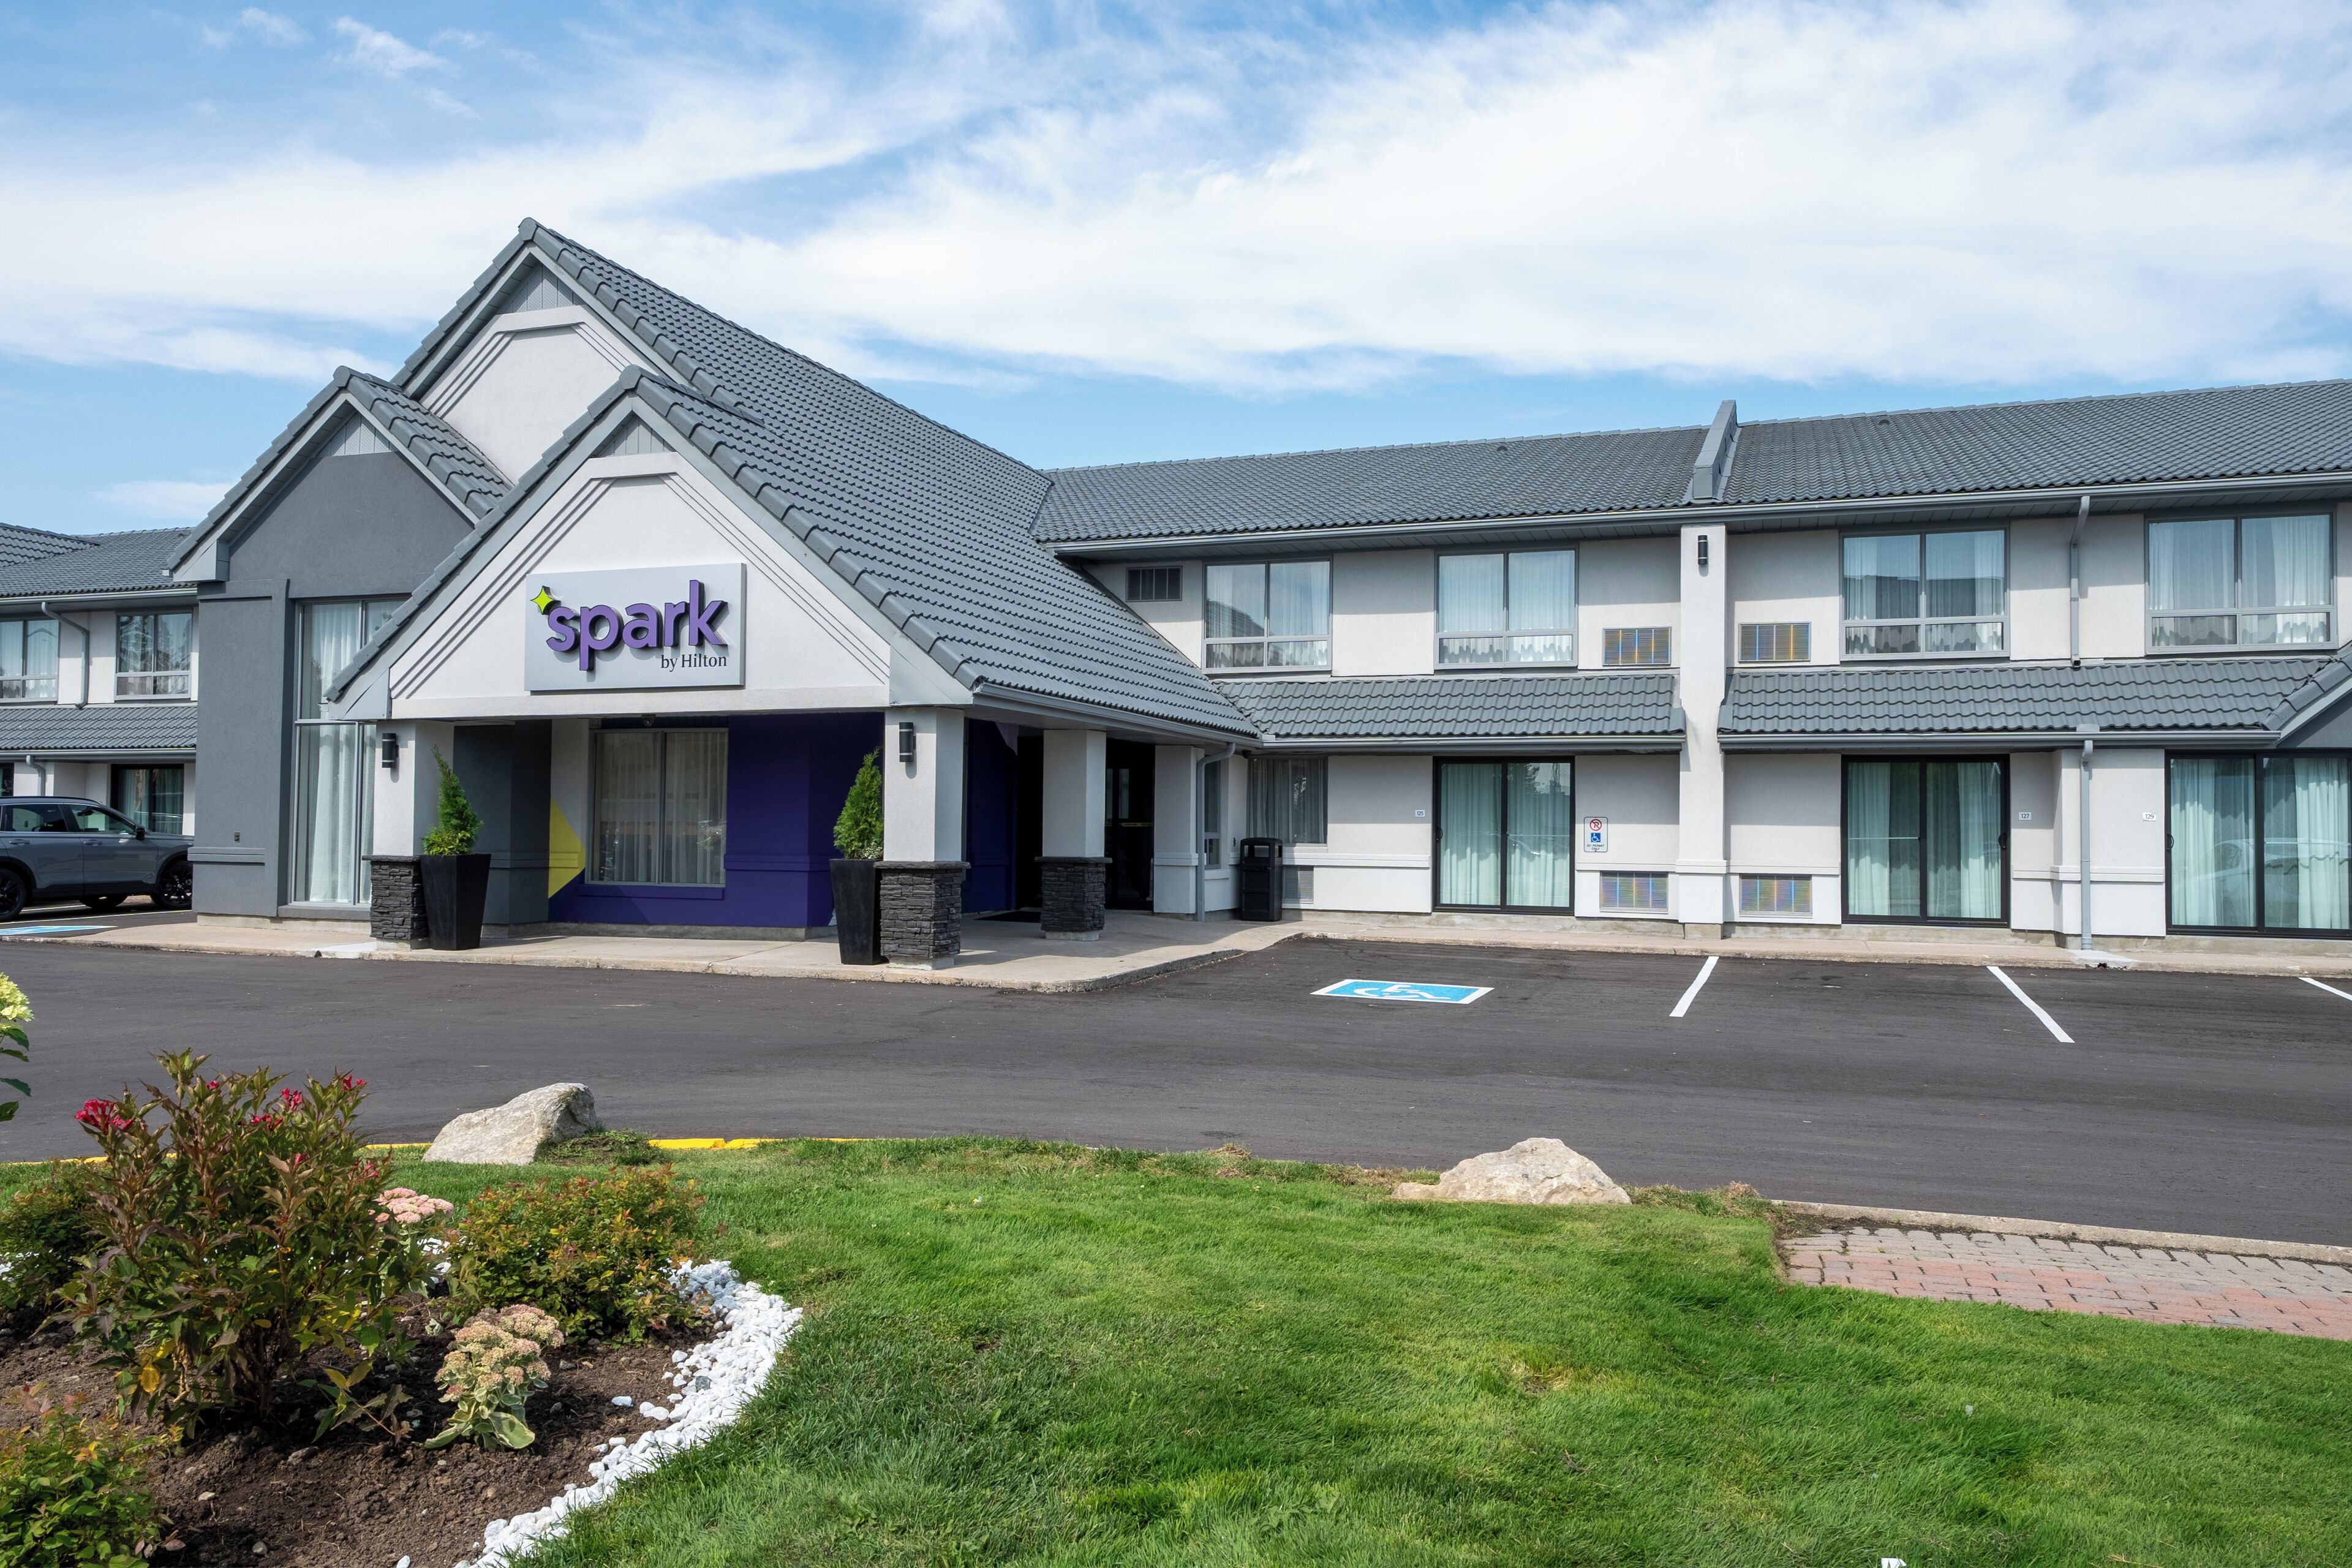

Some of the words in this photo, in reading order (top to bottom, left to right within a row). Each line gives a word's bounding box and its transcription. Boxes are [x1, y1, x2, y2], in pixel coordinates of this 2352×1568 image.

[546, 579, 728, 671] spark
[661, 655, 678, 672] by
[681, 654, 727, 668] Hilton
